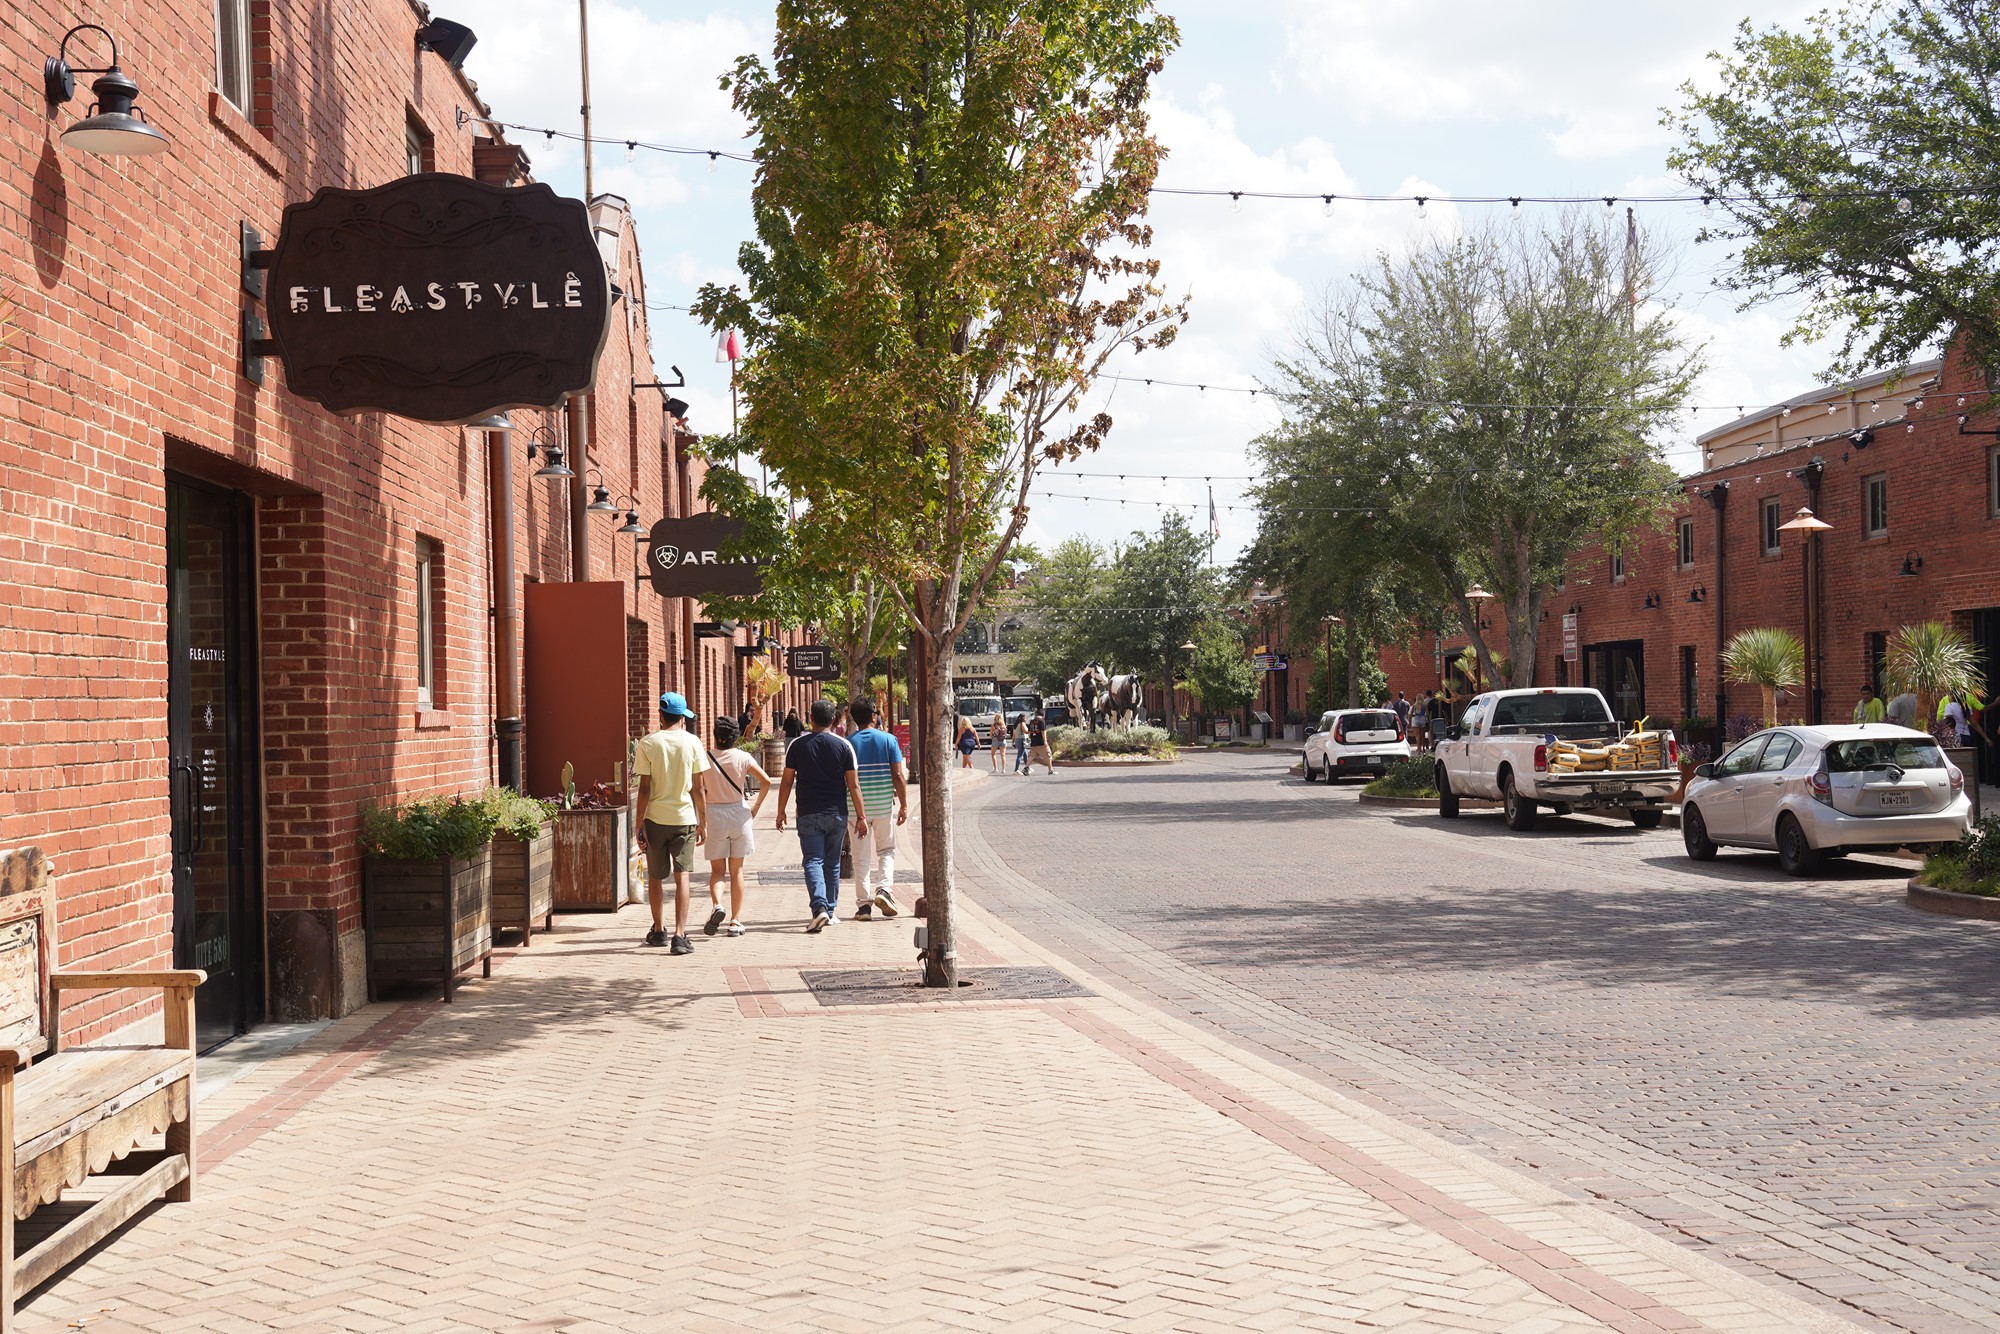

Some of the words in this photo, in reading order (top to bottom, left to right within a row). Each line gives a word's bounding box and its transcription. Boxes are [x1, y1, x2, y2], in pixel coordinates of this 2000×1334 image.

[290, 276, 582, 313] FLEASTYLE
[190, 648, 225, 661] FLEASTYLE
[959, 665, 994, 674] WEST
[195, 940, 212, 969] UITE
[213, 935, 227, 964] 580
